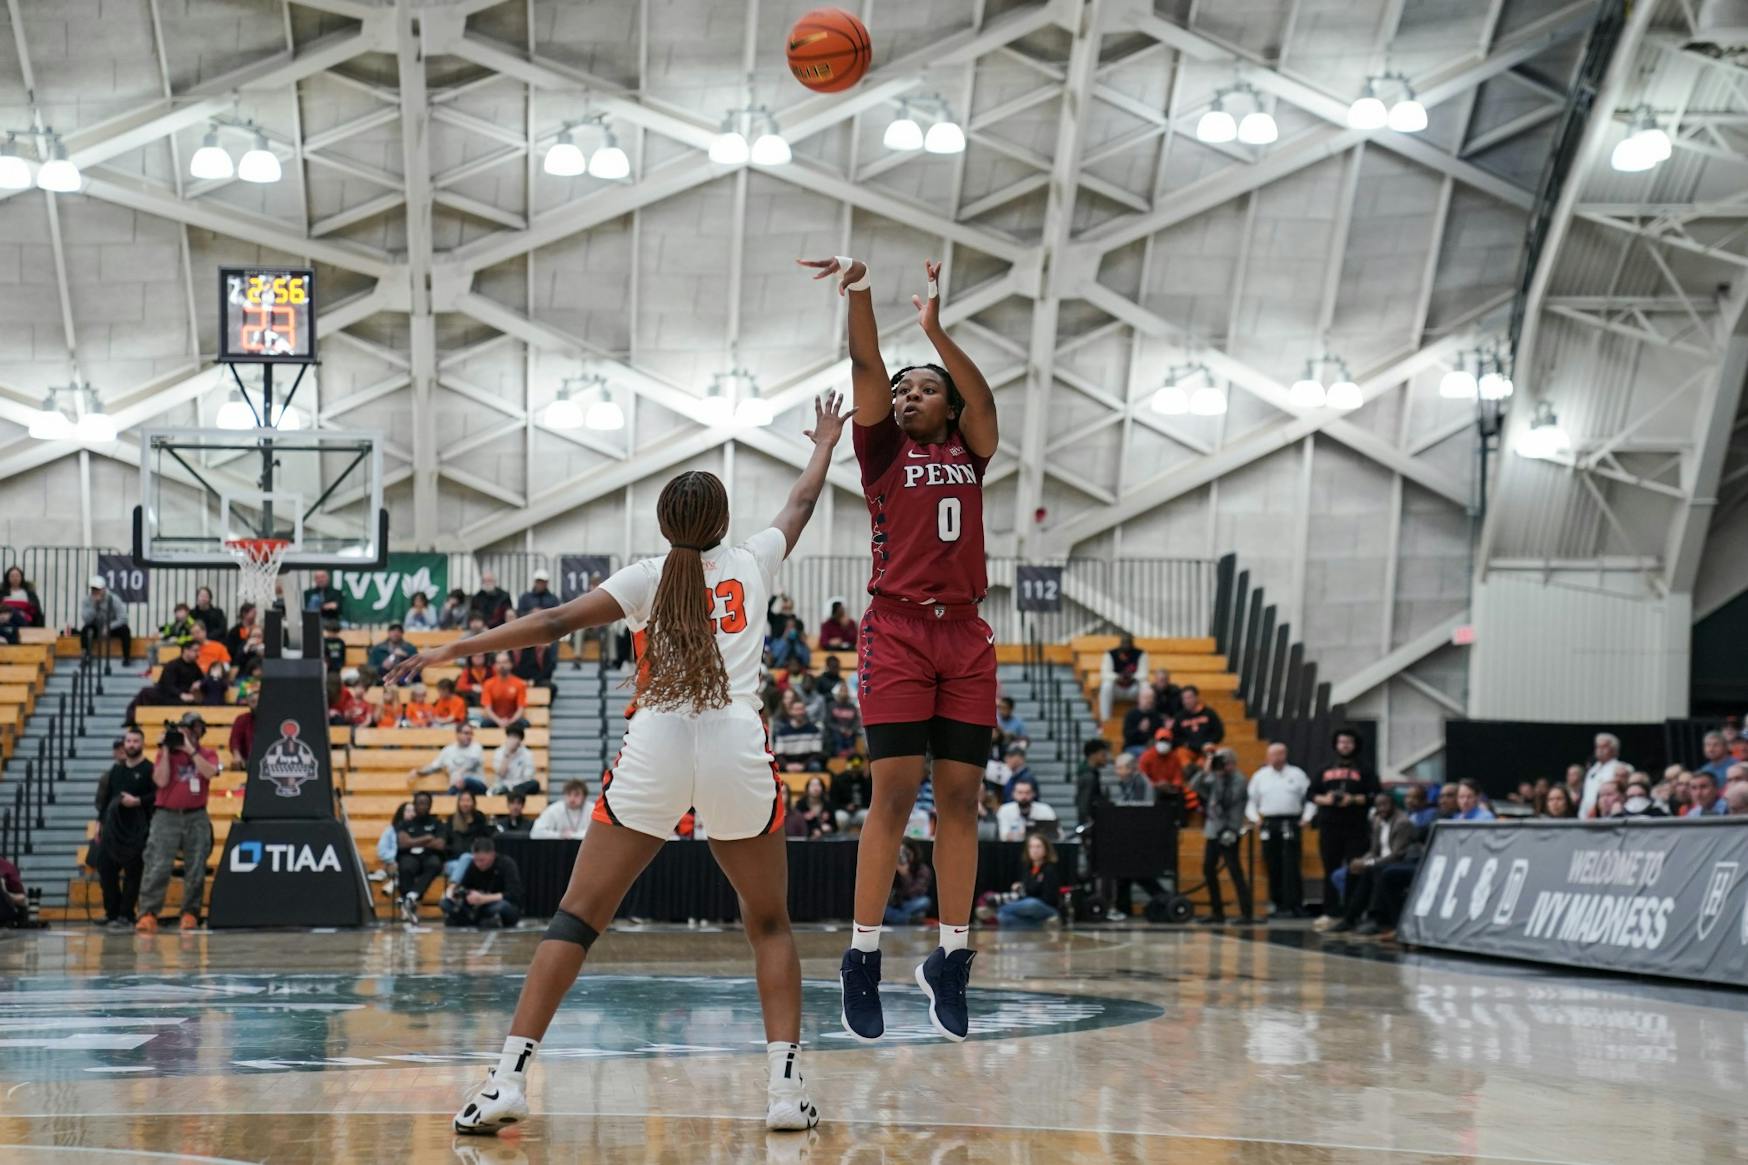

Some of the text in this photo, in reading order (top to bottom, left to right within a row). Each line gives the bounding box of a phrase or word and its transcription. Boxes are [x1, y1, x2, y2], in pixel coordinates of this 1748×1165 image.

[903, 463, 977, 488] PENN
[938, 497, 961, 542] 0
[107, 570, 143, 590] 110
[567, 571, 601, 591] 11
[1023, 580, 1058, 600] 112
[265, 844, 342, 872] TIAA
[1567, 850, 1665, 886] WELCOME TO
[1523, 891, 1676, 950] IVY MADNESS
